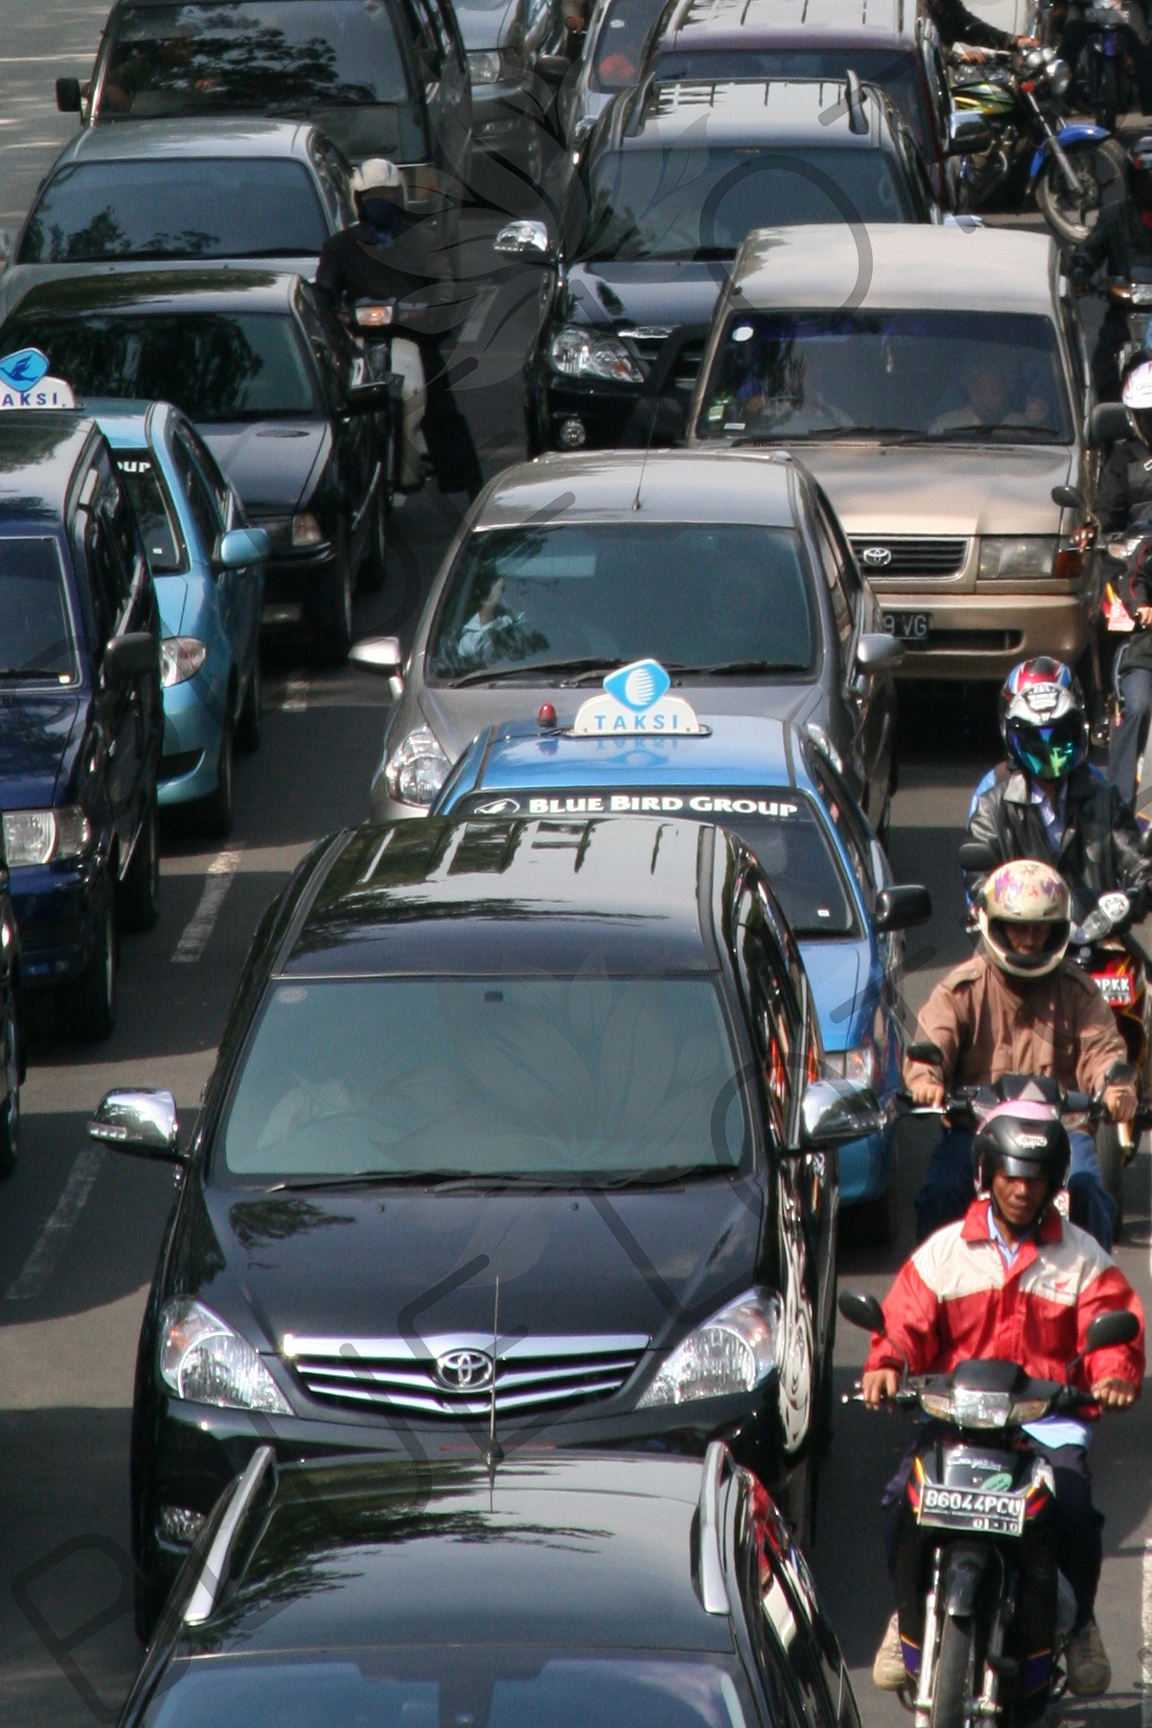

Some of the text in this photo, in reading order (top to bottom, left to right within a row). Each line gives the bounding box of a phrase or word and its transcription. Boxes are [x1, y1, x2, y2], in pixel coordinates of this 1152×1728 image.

[0, 392, 58, 407] AKSI
[903, 615, 928, 637] VG
[594, 714, 678, 731] TAKSI
[529, 795, 798, 817] BLUE BIRD GROUP
